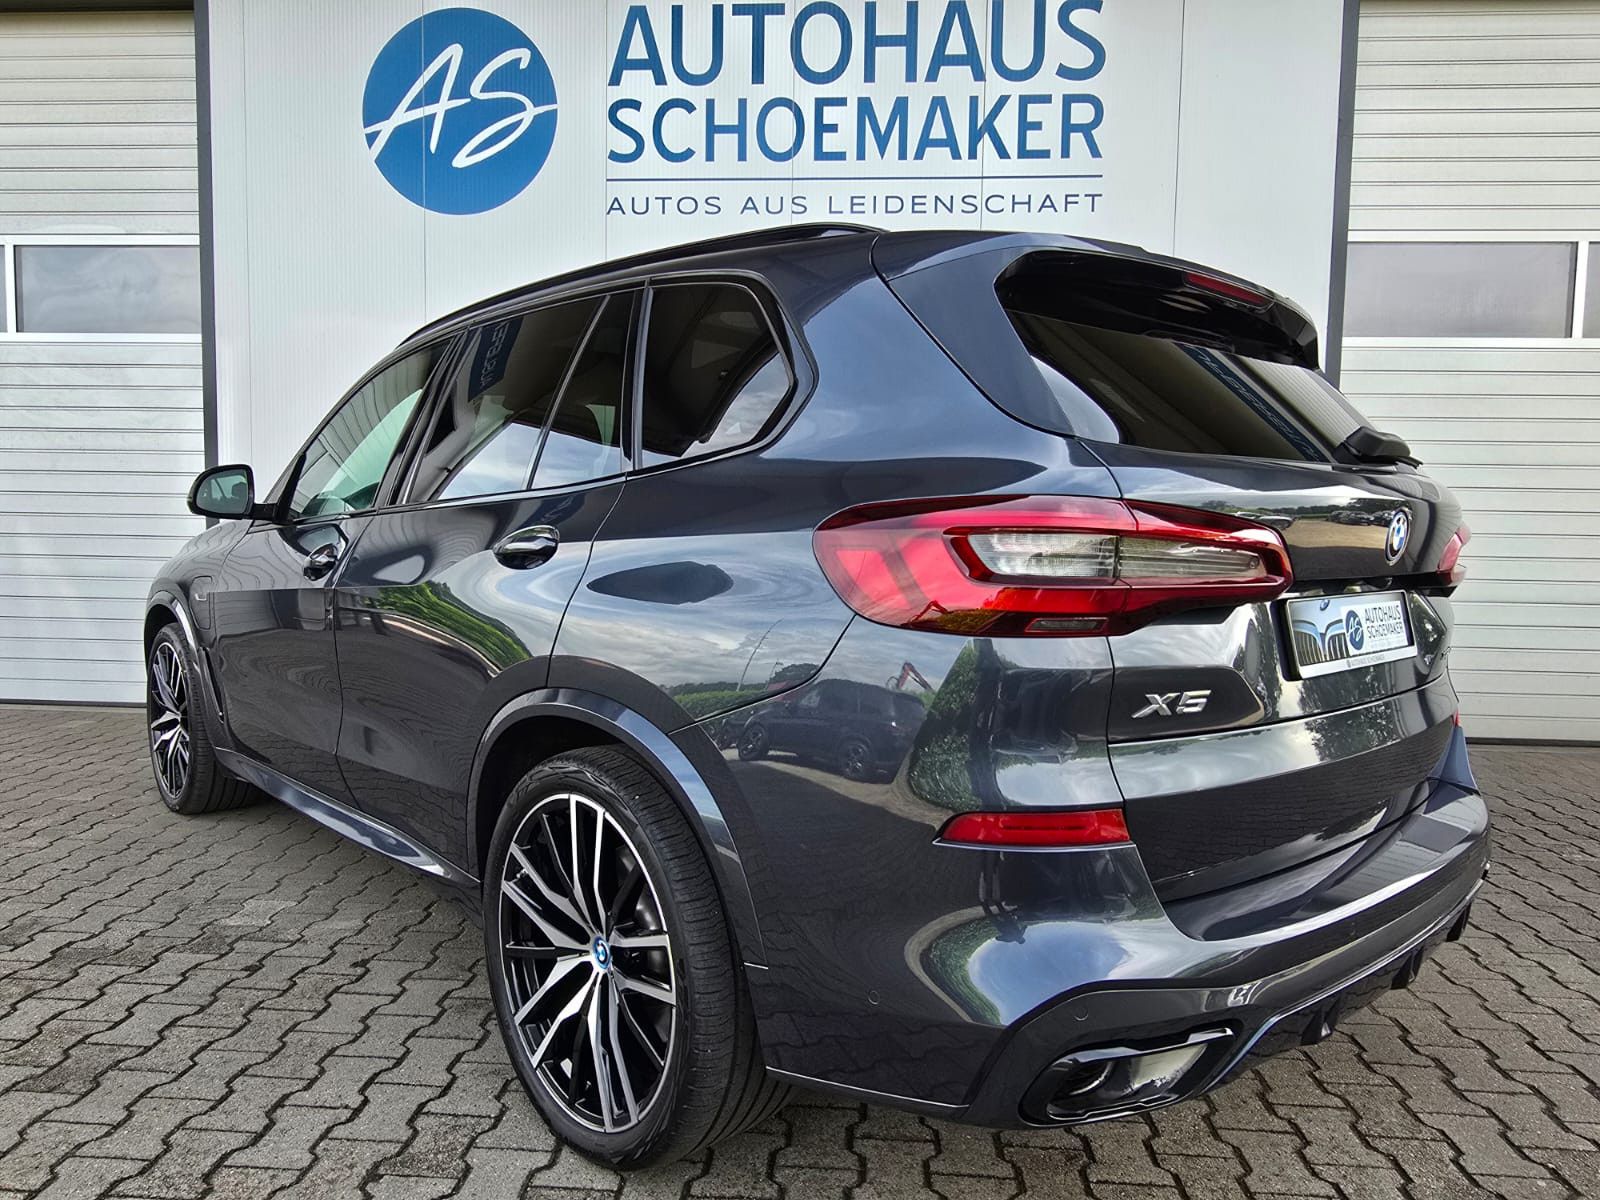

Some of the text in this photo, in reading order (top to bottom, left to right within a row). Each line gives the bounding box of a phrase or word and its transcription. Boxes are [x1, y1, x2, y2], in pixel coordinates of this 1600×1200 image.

[608, 0, 1106, 87] AUTOHAUS
[364, 42, 558, 170] AS
[606, 93, 1105, 164] SCHOEMAKER
[606, 193, 1104, 215] AUTOS AUS LEIDENSCHAFT
[1365, 605, 1402, 623] AUTOHAUS
[1367, 622, 1403, 638] SCHOEMAKER
[1131, 689, 1212, 719] X5
